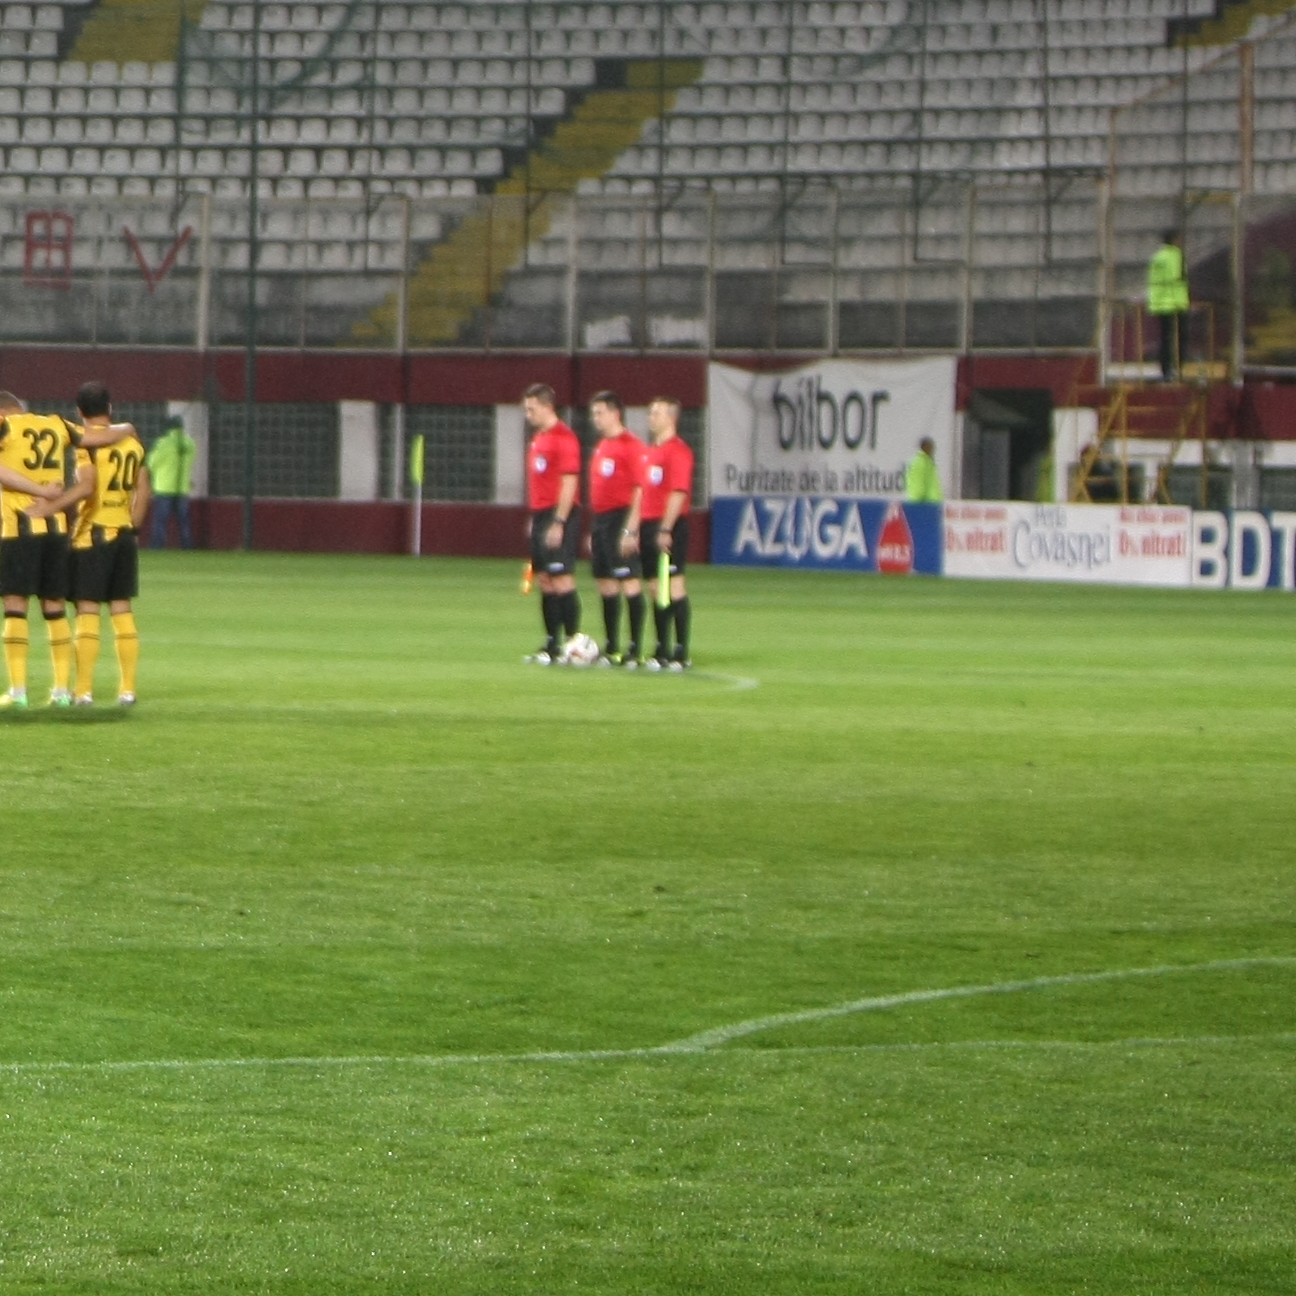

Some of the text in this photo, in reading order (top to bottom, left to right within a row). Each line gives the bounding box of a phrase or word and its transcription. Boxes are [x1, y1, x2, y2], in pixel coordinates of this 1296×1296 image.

[772, 374, 891, 451] bilbor
[22, 427, 60, 470] 32
[108, 449, 138, 491] 20
[724, 463, 793, 492] Puritate
[823, 464, 839, 492] la
[734, 498, 869, 560] AZUGA
[1013, 519, 1111, 570] Covasnei
